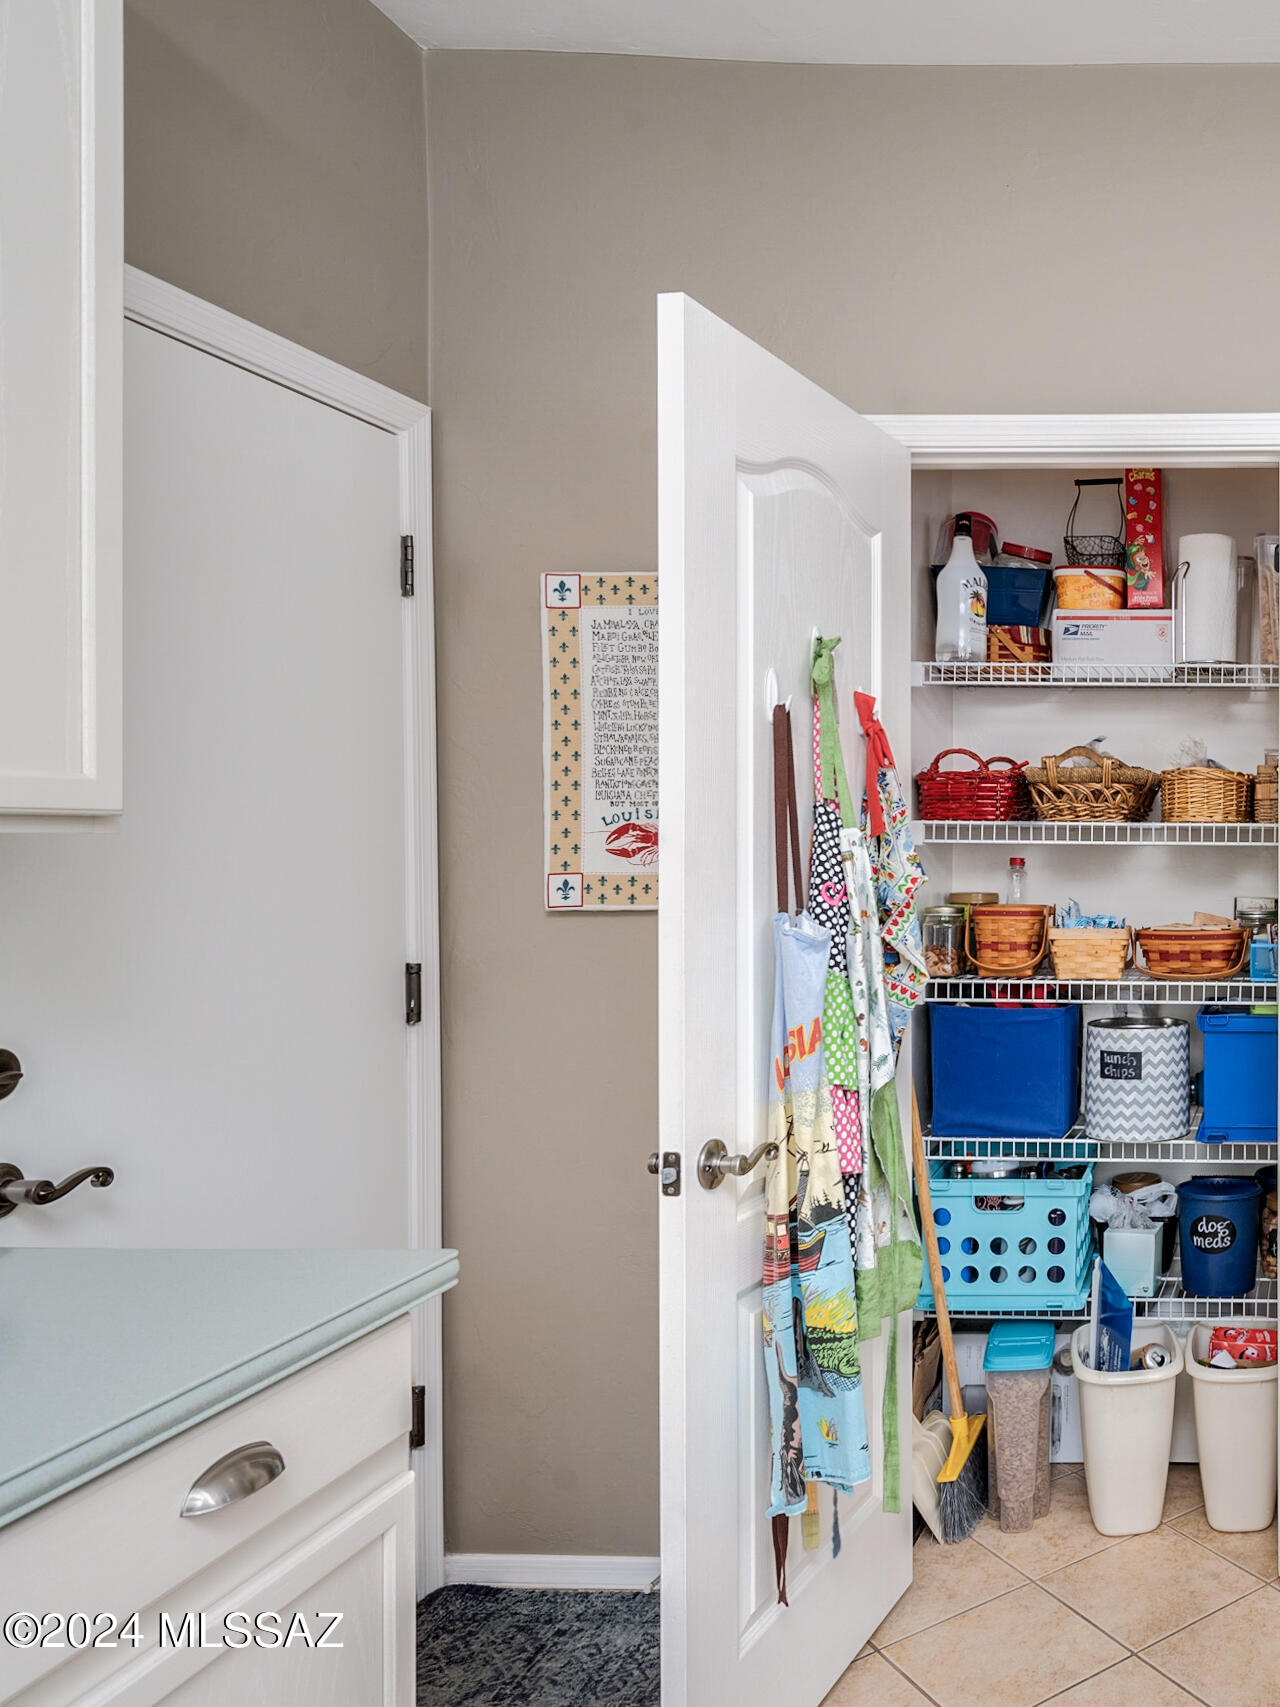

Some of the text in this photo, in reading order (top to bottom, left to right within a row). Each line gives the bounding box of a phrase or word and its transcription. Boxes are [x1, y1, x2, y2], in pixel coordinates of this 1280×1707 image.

[1103, 1052, 1137, 1066] lunch
[1104, 1065, 1136, 1080] chips
[1197, 1216, 1231, 1237] dog
[1193, 1233, 1231, 1249] meds
